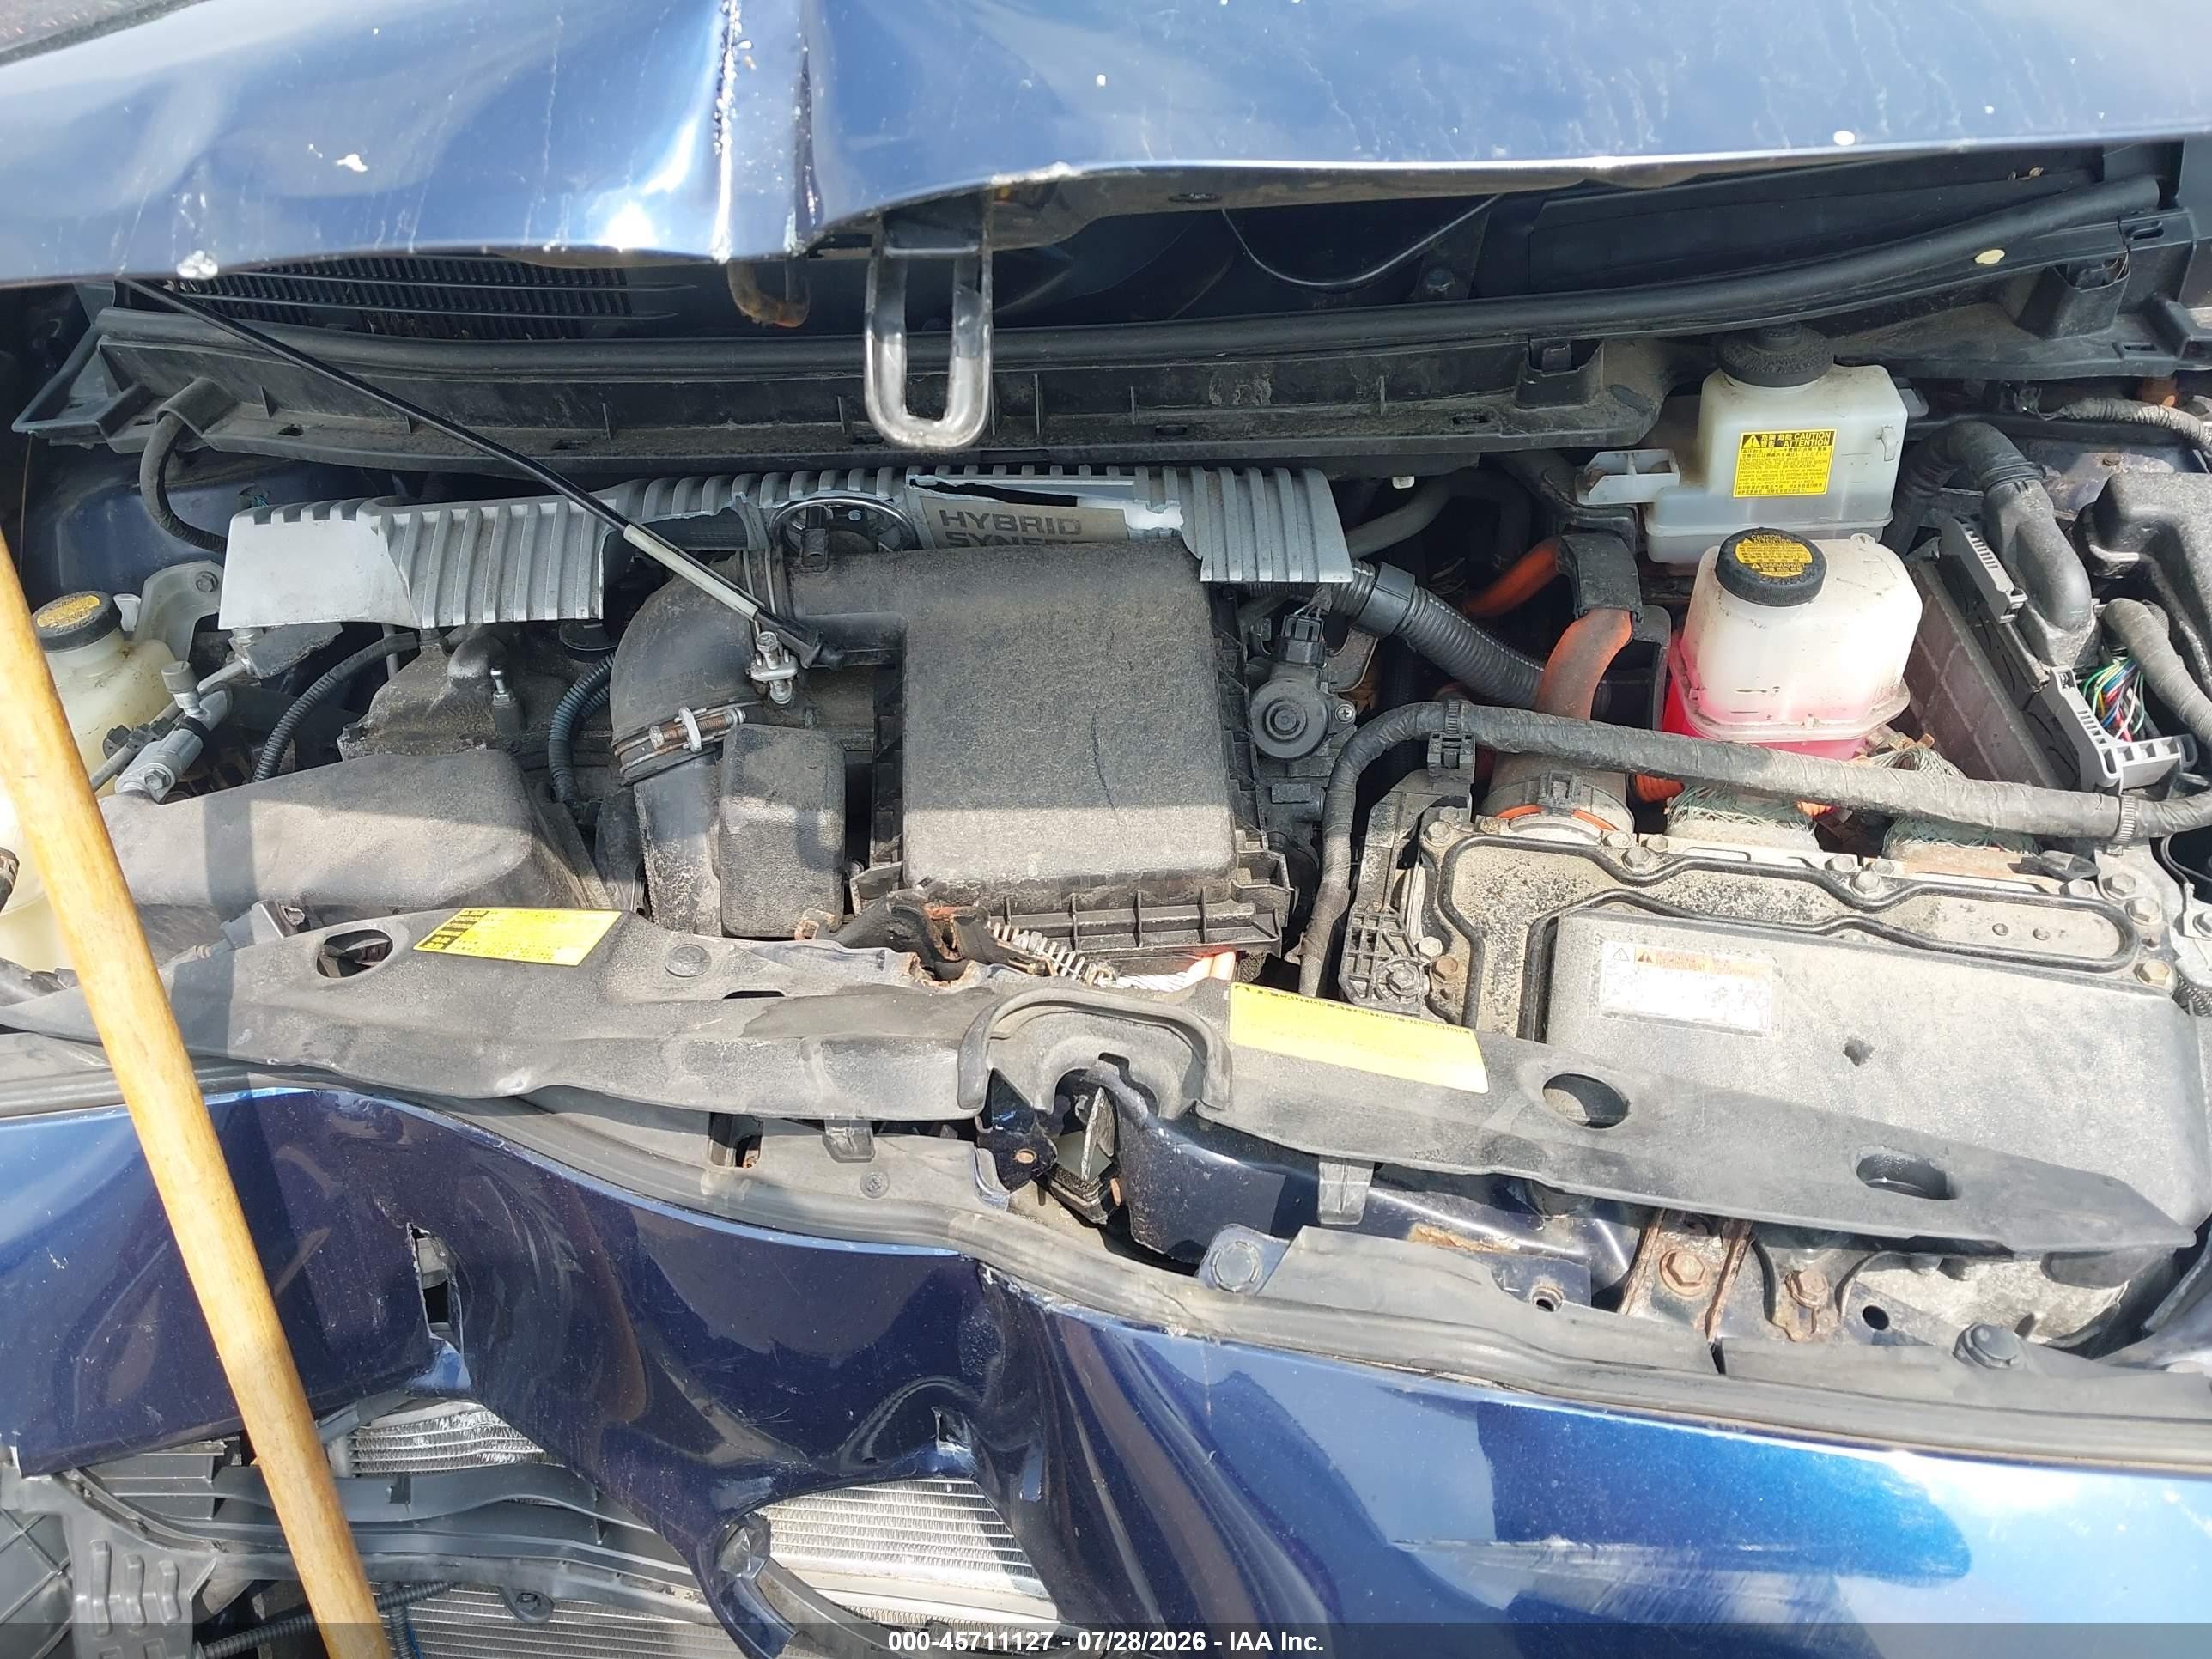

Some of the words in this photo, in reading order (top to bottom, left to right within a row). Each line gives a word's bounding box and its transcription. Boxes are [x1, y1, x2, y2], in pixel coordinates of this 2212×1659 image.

[1794, 431, 1831, 440] CAUTION
[1784, 439, 1830, 447] ATTENTION
[939, 509, 1082, 536] HYBRID
